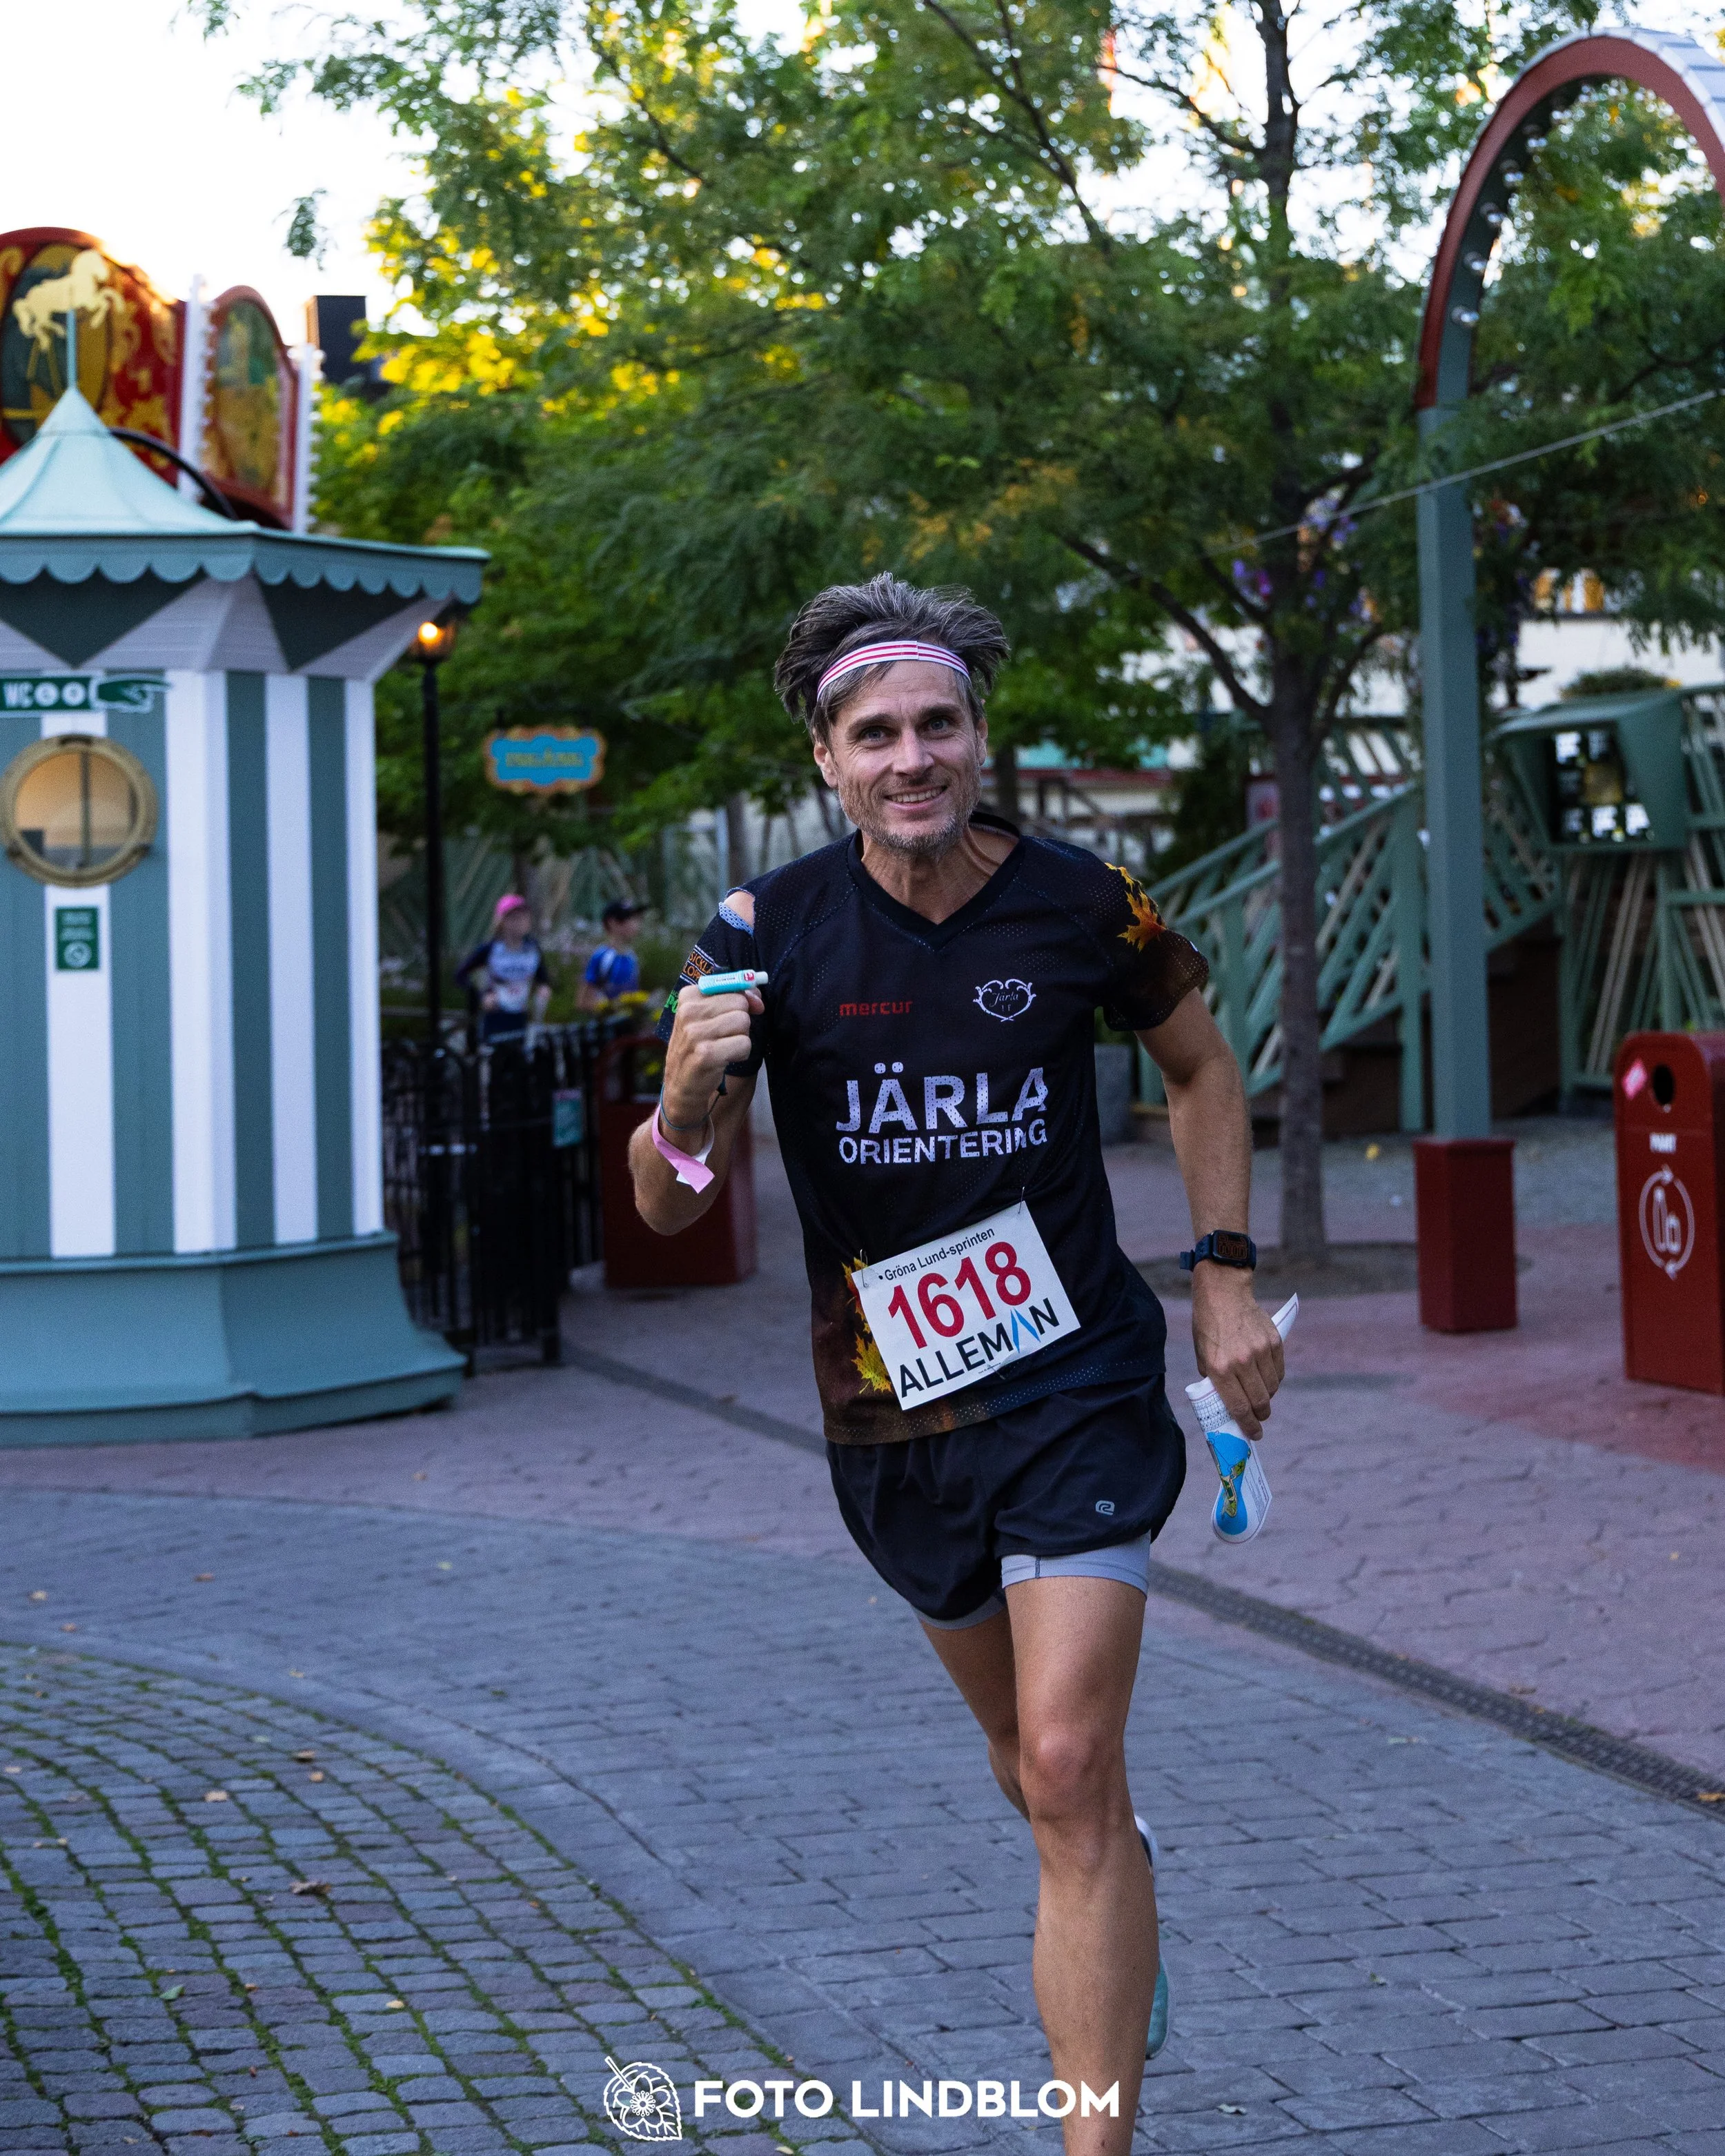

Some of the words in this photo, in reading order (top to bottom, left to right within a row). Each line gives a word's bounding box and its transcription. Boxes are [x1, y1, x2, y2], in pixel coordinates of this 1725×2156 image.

[839, 1000, 914, 1016] mercur
[836, 1061, 1048, 1134] JÄRLA
[839, 1118, 1047, 1165] ORIENTERING
[884, 1263, 917, 1281] Gröna
[917, 1227, 995, 1269] Lund-sprinten
[888, 1241, 1032, 1349] 1618
[900, 1297, 1061, 1398] ALLEMAN
